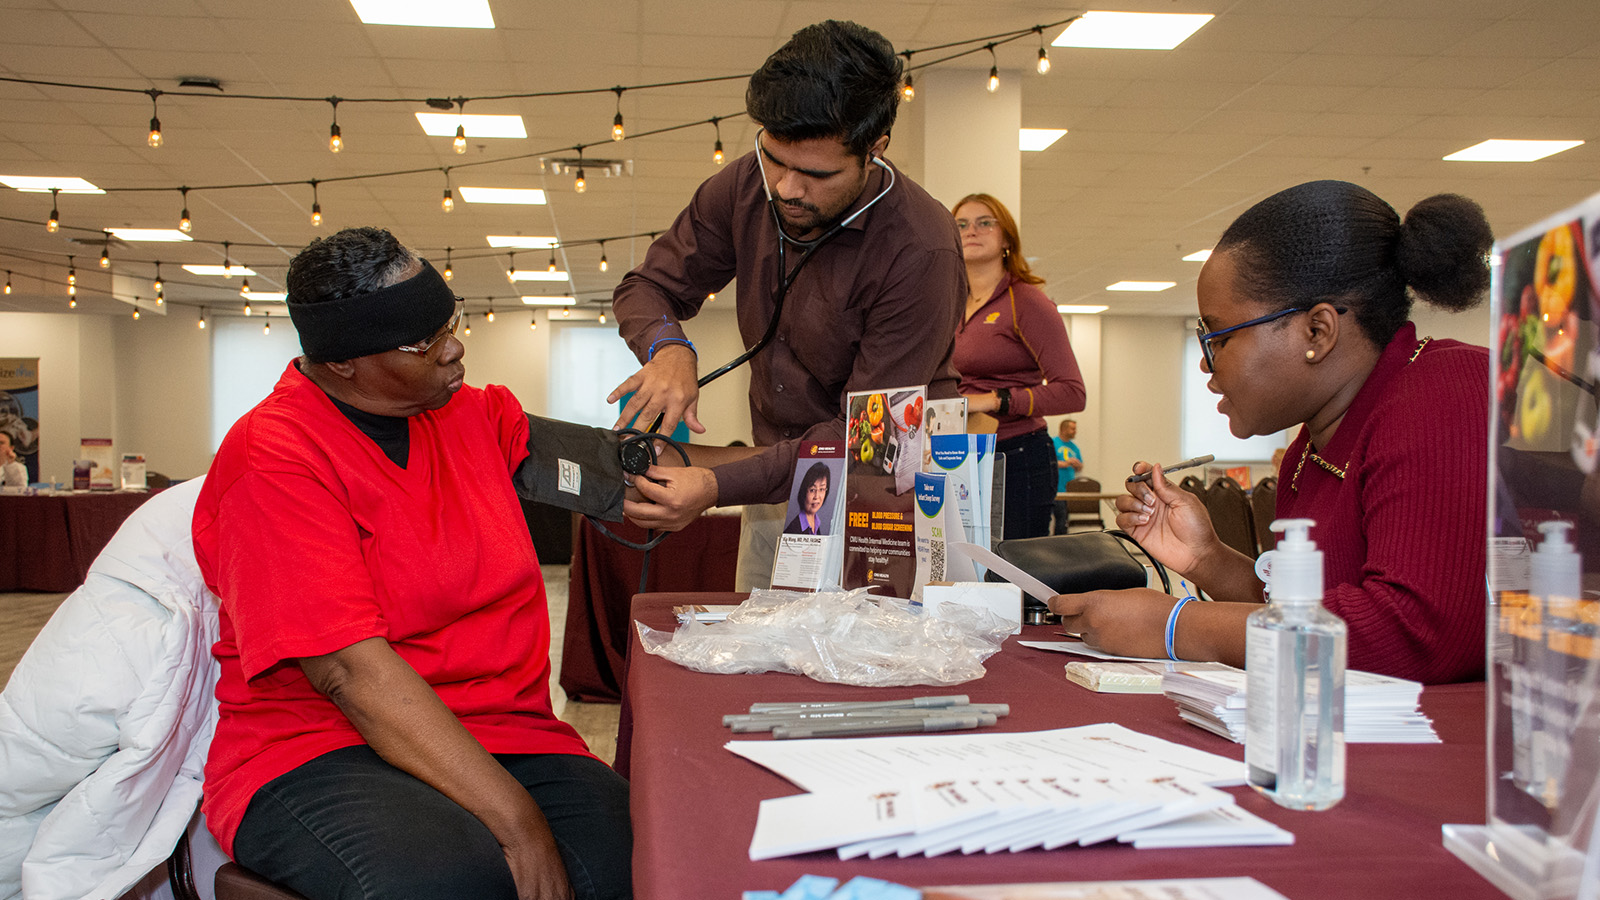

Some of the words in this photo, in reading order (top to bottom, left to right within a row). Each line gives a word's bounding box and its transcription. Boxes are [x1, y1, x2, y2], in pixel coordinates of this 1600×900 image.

[849, 512, 869, 528] FREE!
[932, 527, 942, 537] SCAN
[870, 547, 881, 555] helping
